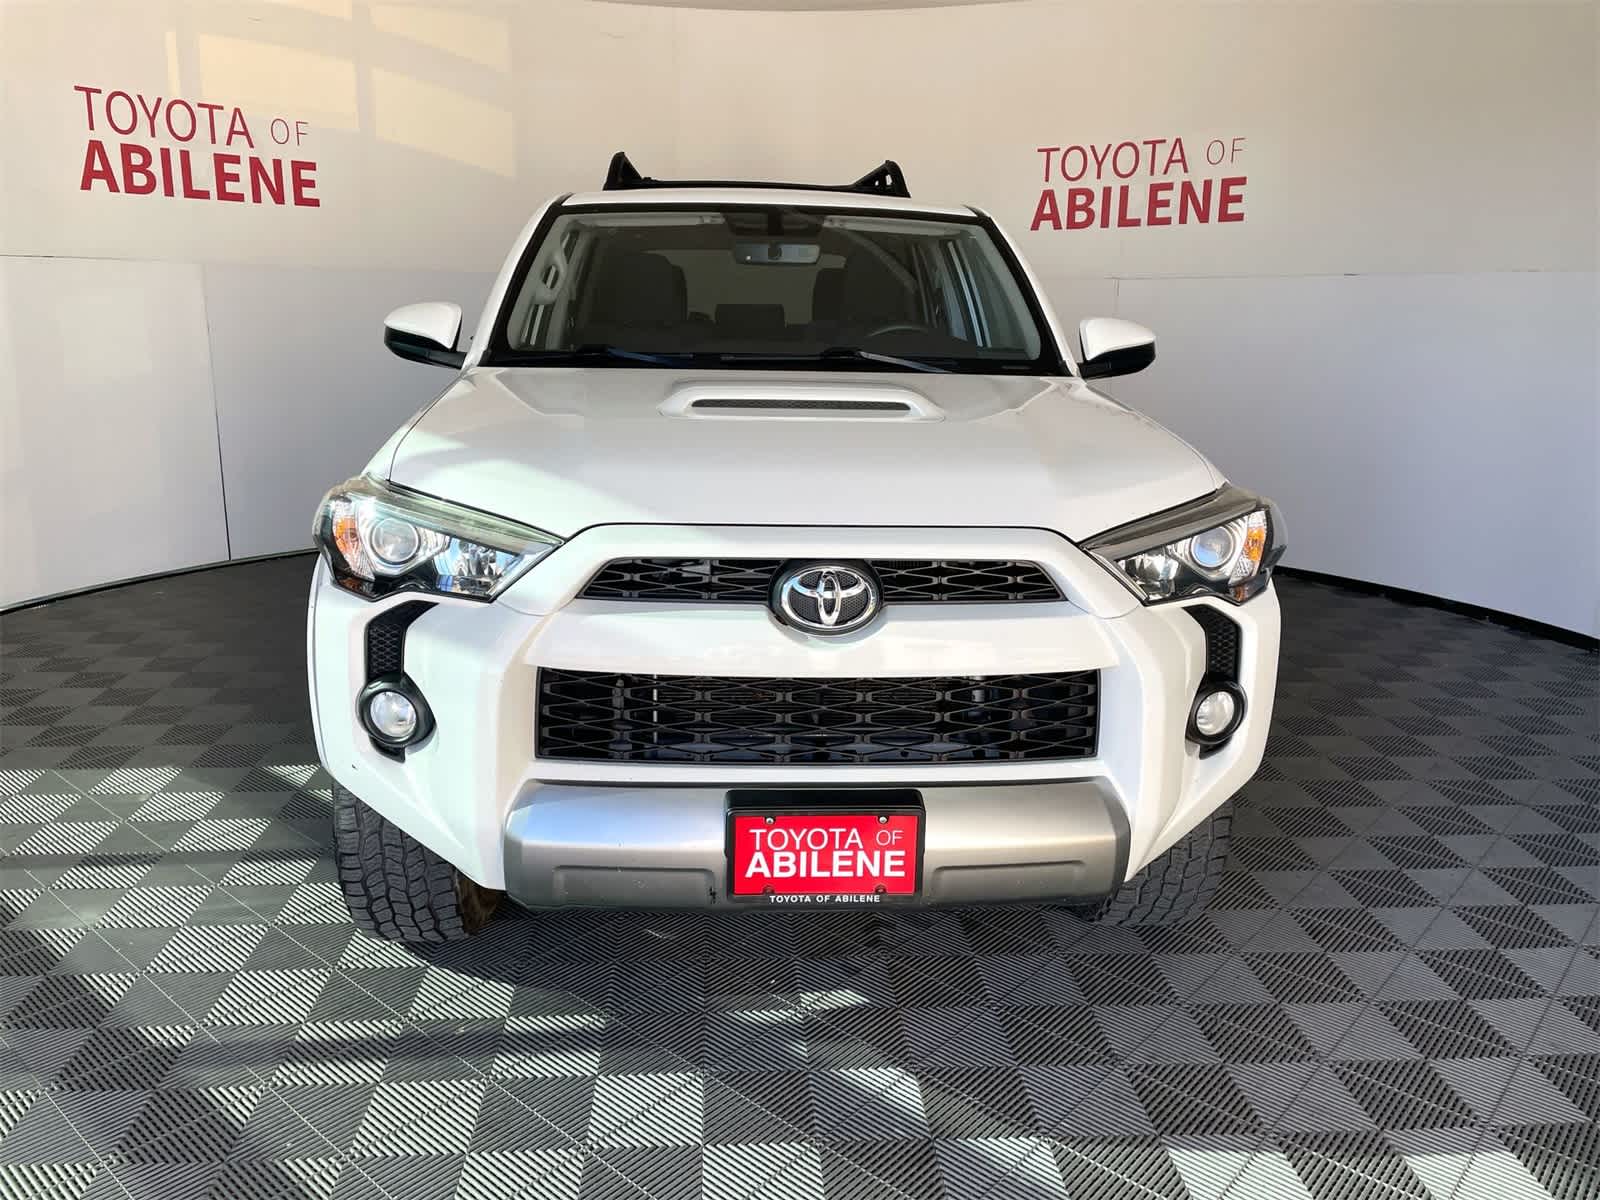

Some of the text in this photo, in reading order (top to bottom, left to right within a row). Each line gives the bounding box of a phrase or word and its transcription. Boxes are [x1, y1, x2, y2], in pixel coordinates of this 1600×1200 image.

[74, 84, 310, 149] TOYOTA OF
[80, 139, 320, 208] ABILENE
[1036, 136, 1247, 182] TOYOTA OF
[1030, 176, 1248, 232] ABILENE
[749, 828, 904, 851] TOYOTA OF
[745, 850, 906, 878] ABILENE
[769, 894, 881, 904] TOYOTA OF ABILENE
